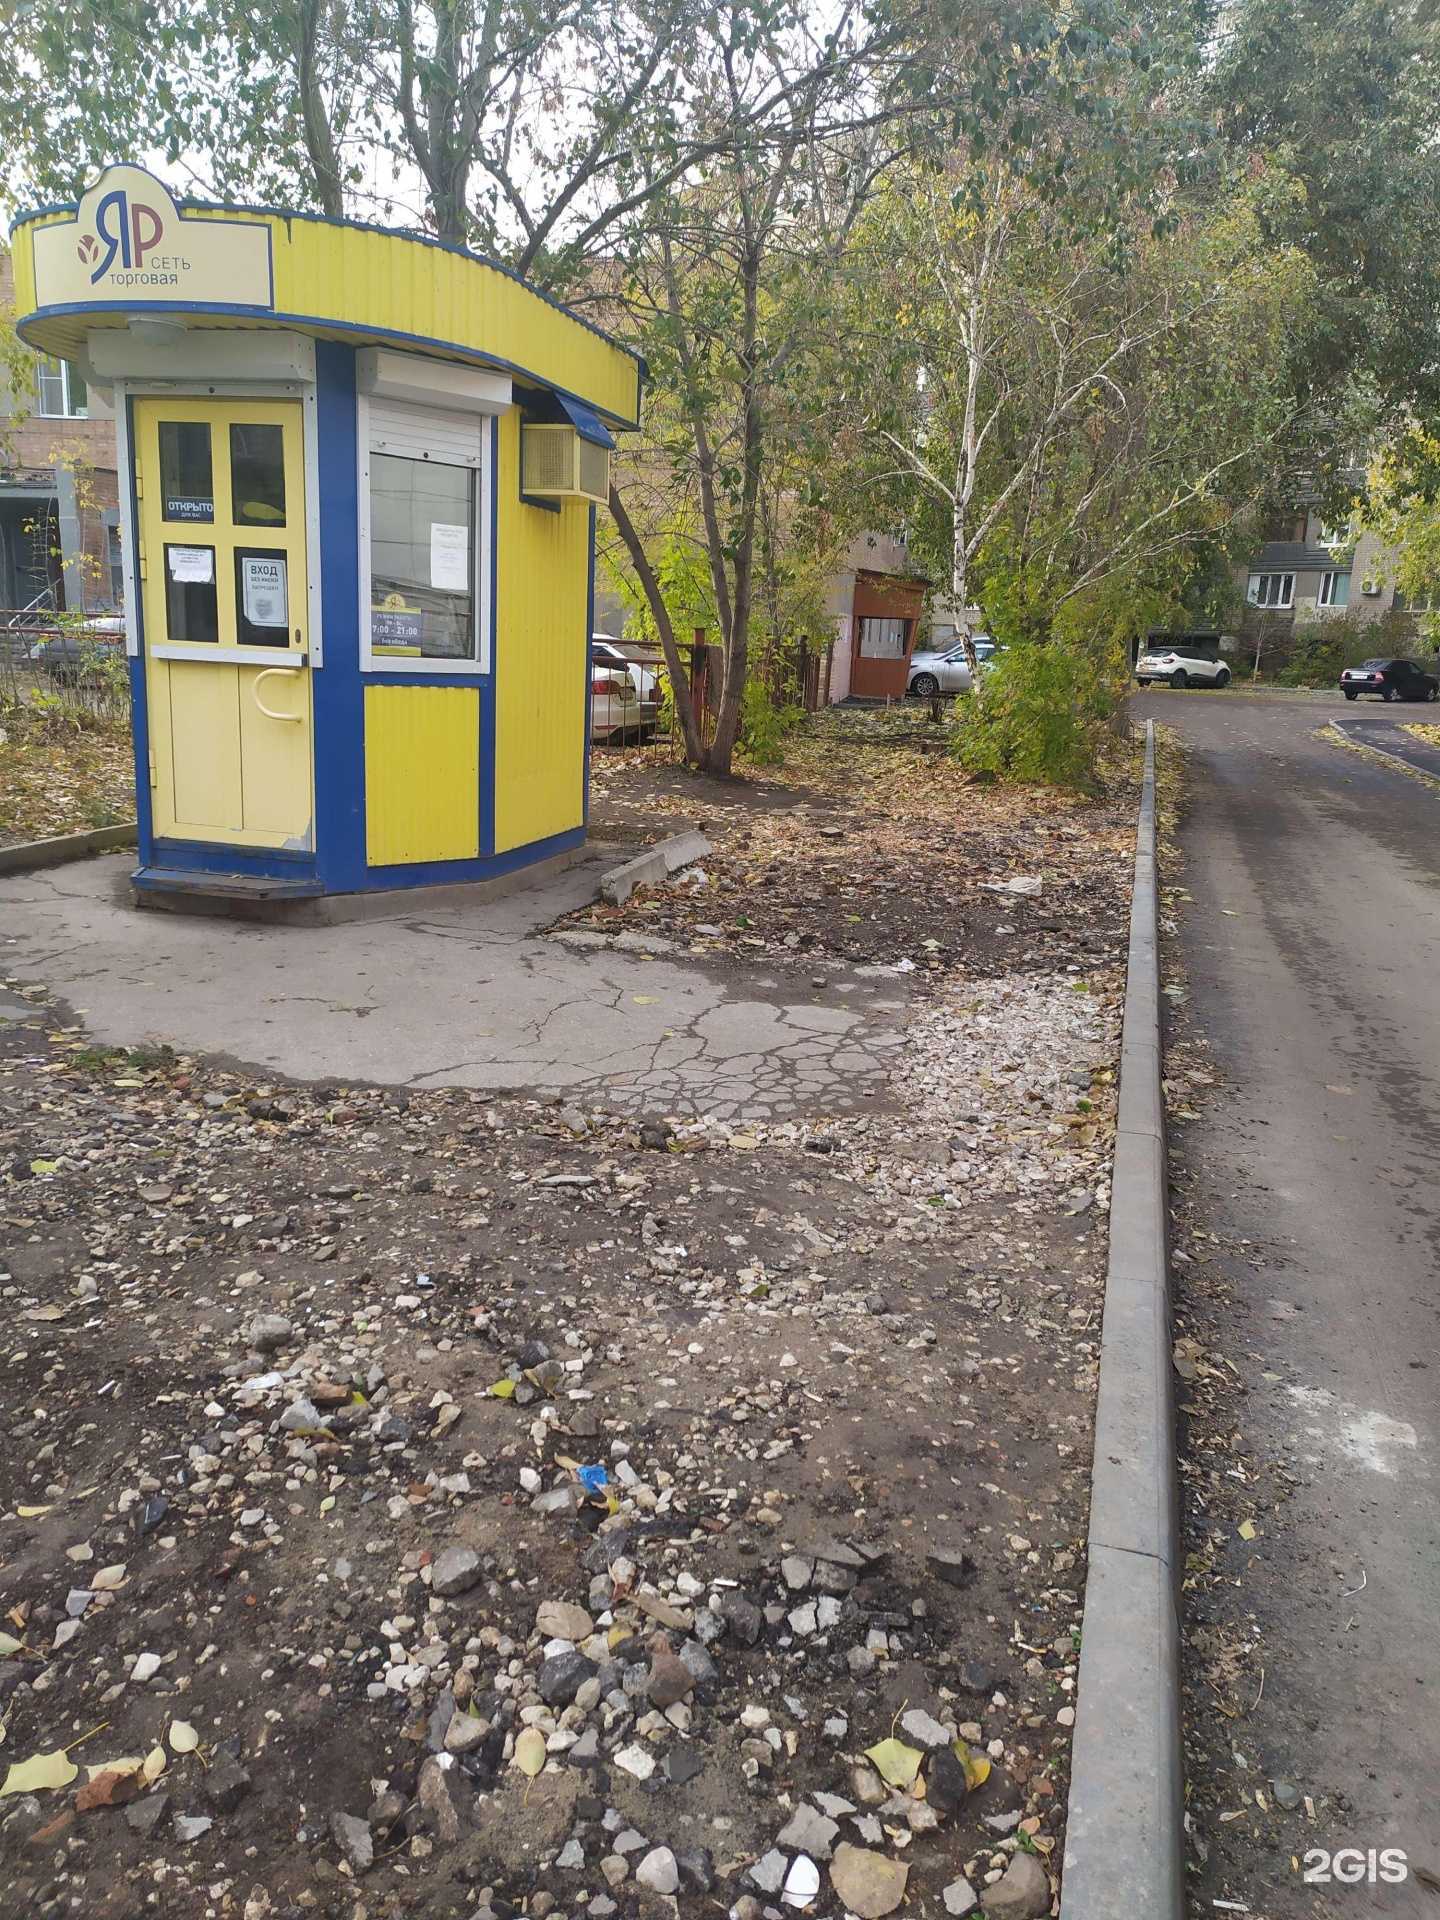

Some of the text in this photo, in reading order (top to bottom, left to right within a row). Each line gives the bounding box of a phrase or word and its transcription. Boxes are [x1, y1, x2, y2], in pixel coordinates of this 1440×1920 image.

[91, 190, 164, 285] ЯР
[151, 257, 191, 270] СЕТЬ
[110, 273, 178, 287] торговая
[168, 501, 214, 512] ОТКРЫТО
[250, 565, 278, 577] ВХОД
[396, 626, 418, 635] 21:00
